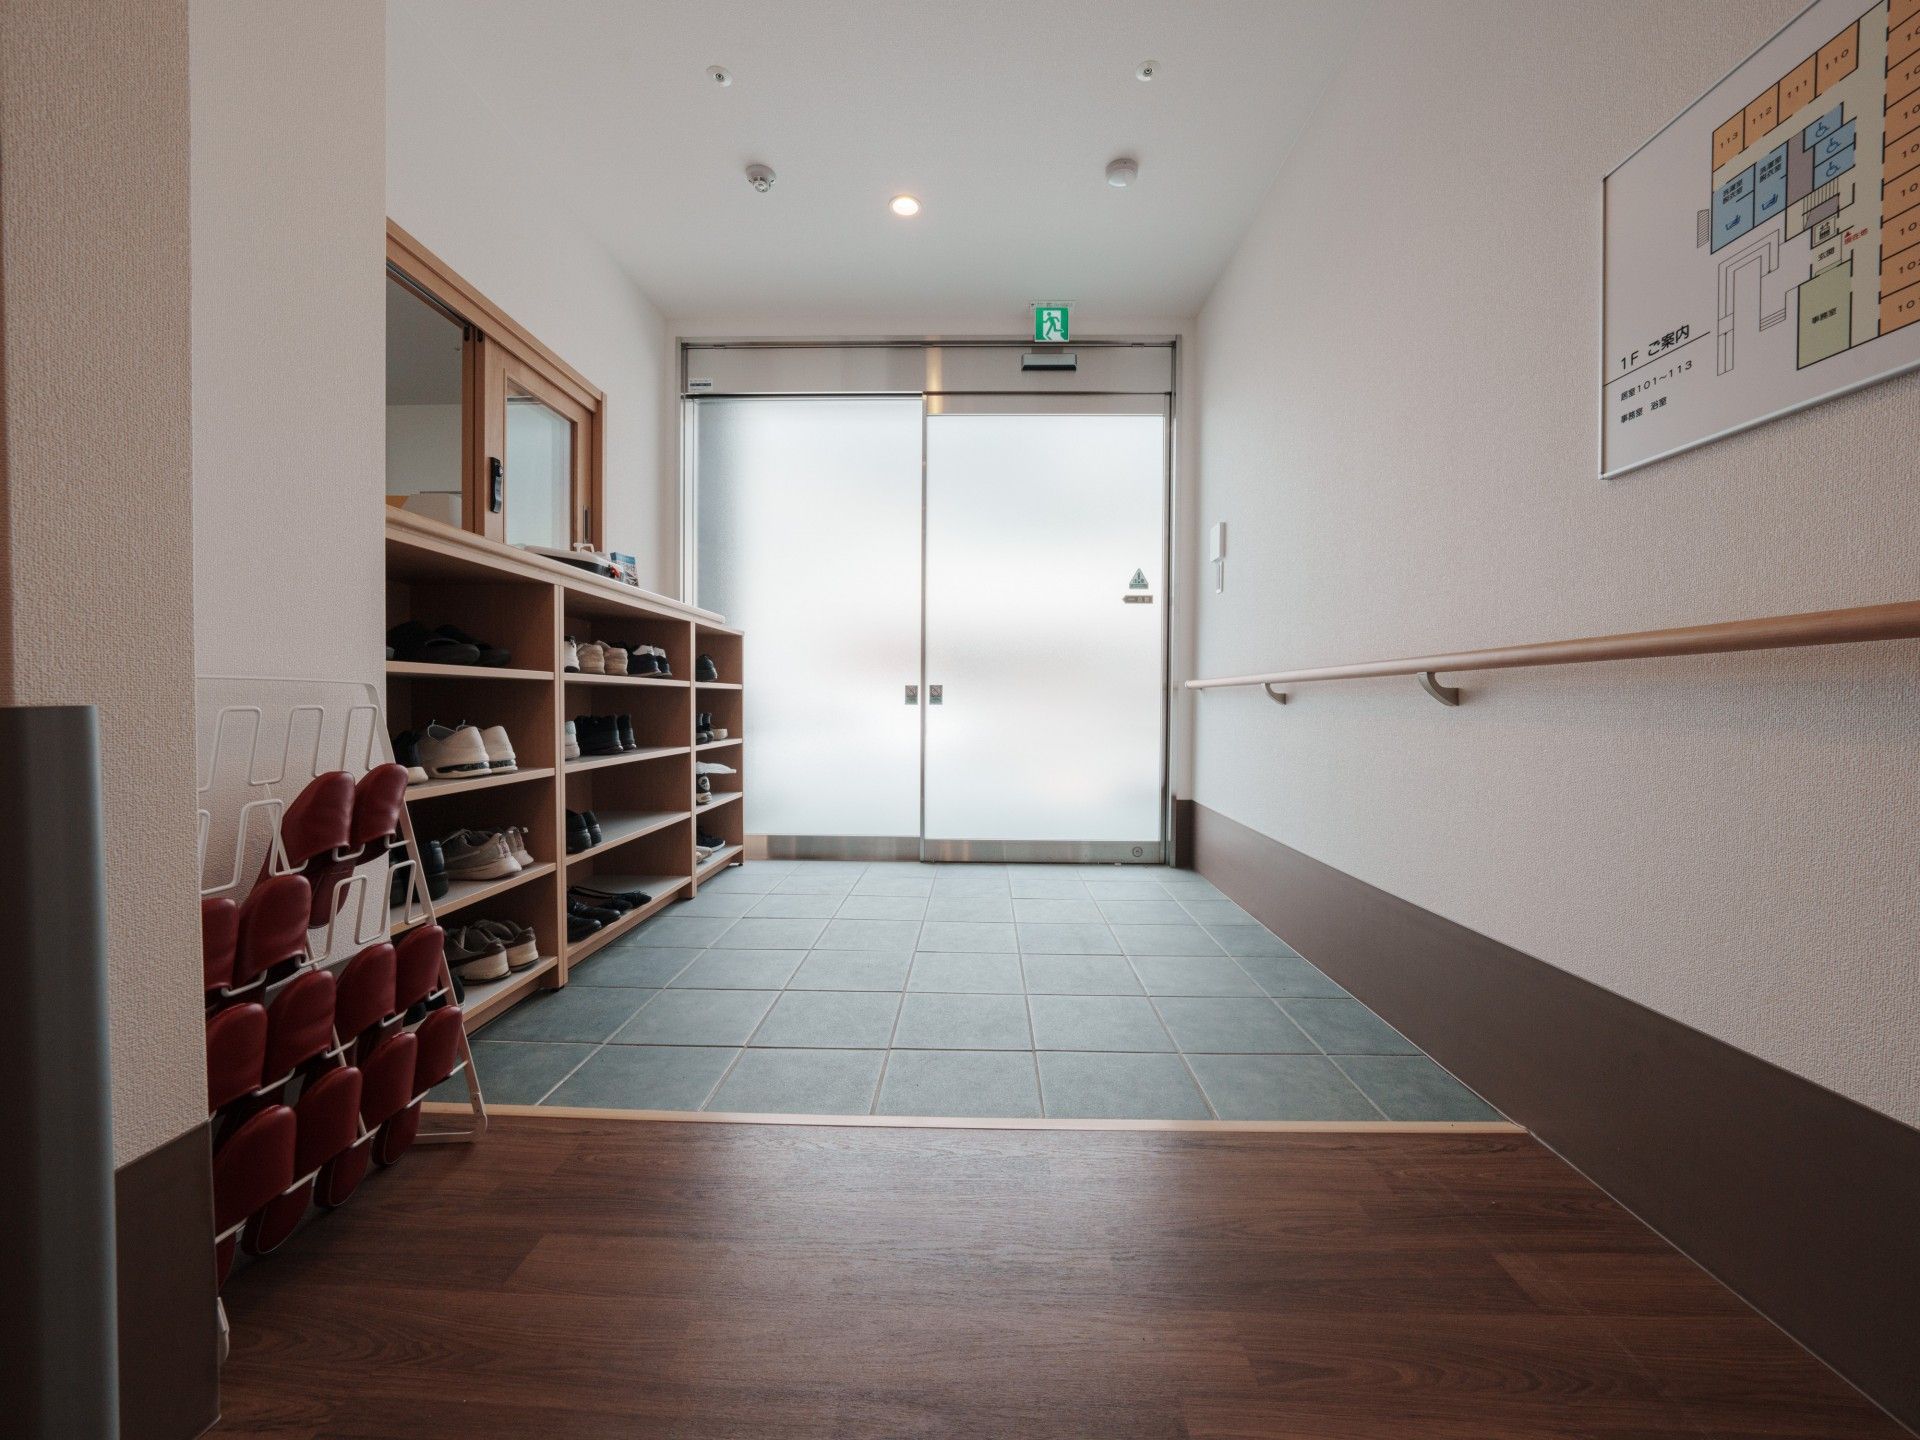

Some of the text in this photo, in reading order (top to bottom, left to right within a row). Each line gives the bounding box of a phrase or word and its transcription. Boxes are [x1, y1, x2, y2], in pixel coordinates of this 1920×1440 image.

[1825, 49, 1849, 70] 110
[1787, 80, 1807, 98] 111
[1752, 106, 1772, 124] 112
[1720, 132, 1738, 149] 113
[1621, 324, 1690, 370] 1F ご案内
